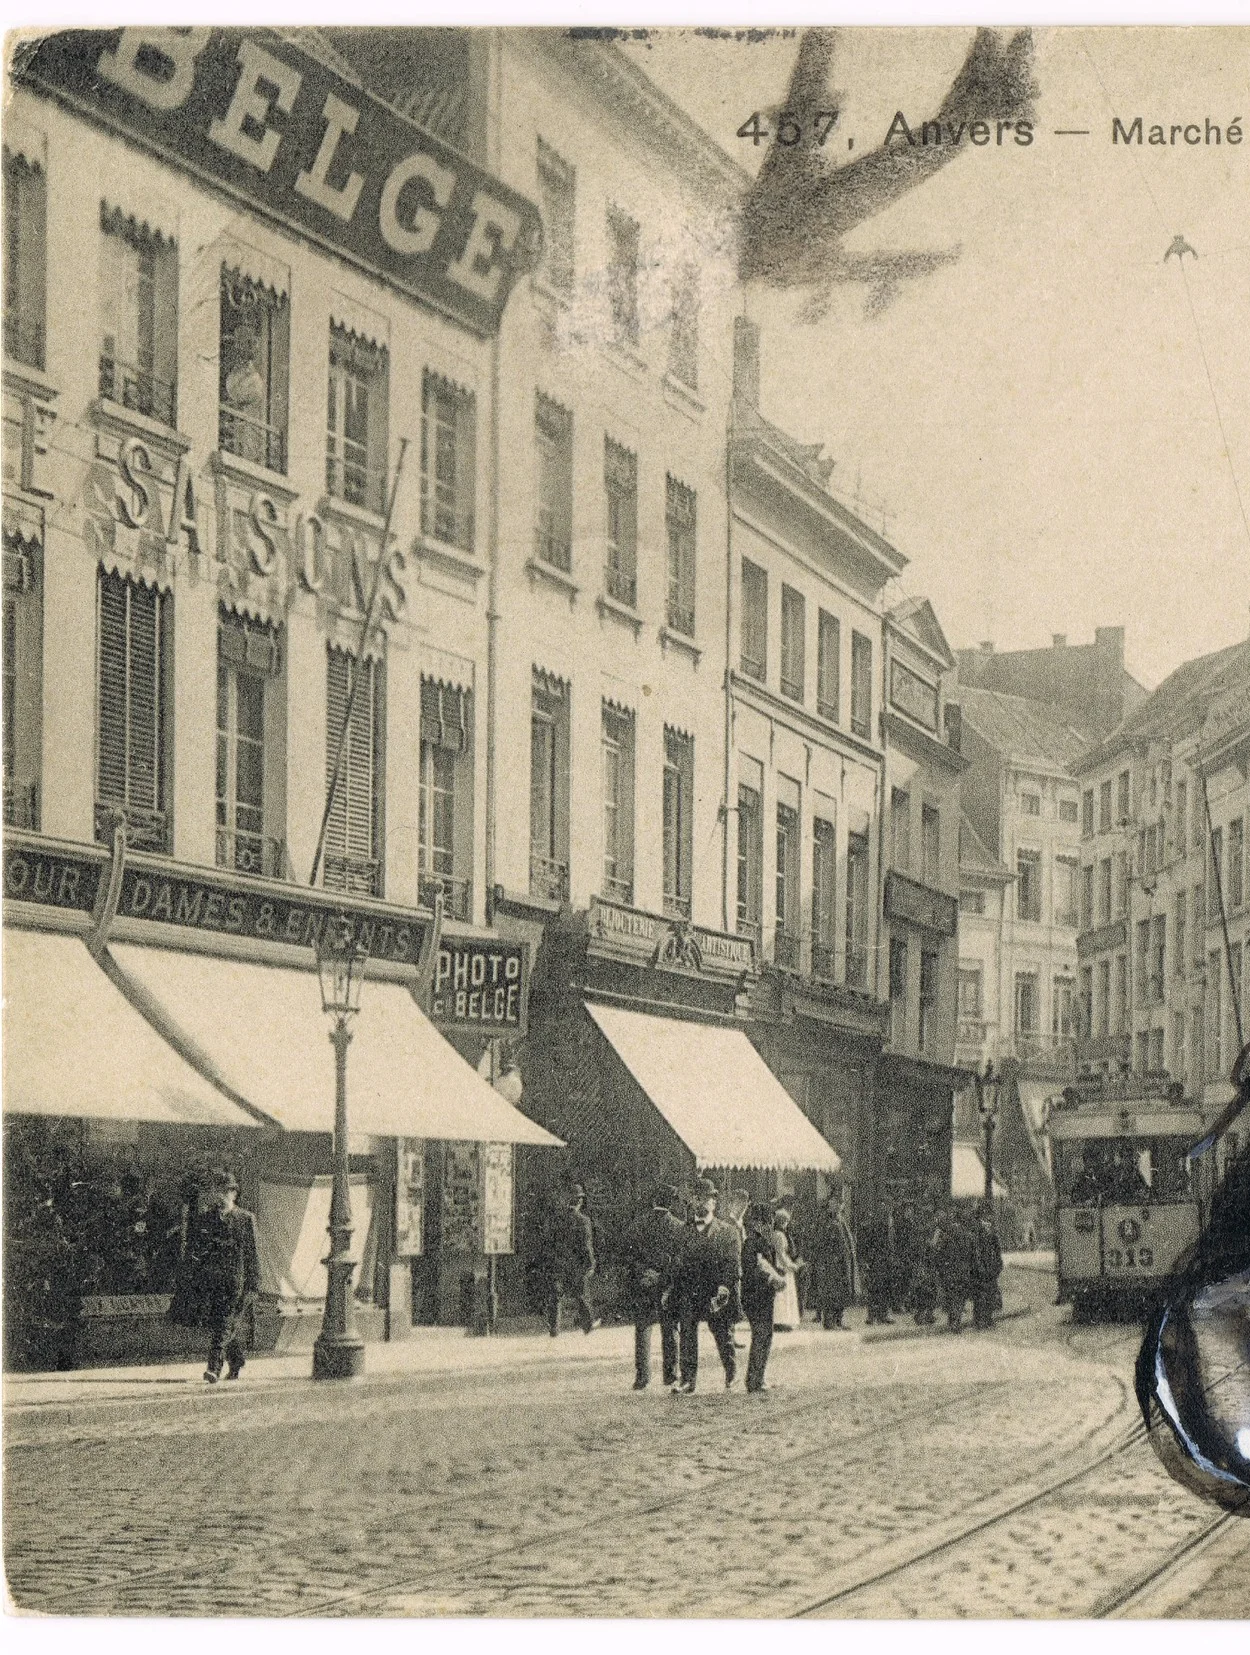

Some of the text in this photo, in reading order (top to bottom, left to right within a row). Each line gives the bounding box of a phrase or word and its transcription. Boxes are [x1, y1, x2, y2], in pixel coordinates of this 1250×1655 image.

[97, 26, 522, 301] BELGE
[131, 877, 247, 929] DAMES
[255, 902, 275, 935] &
[434, 950, 520, 993] PHOTO
[455, 983, 519, 1022] BELGE
